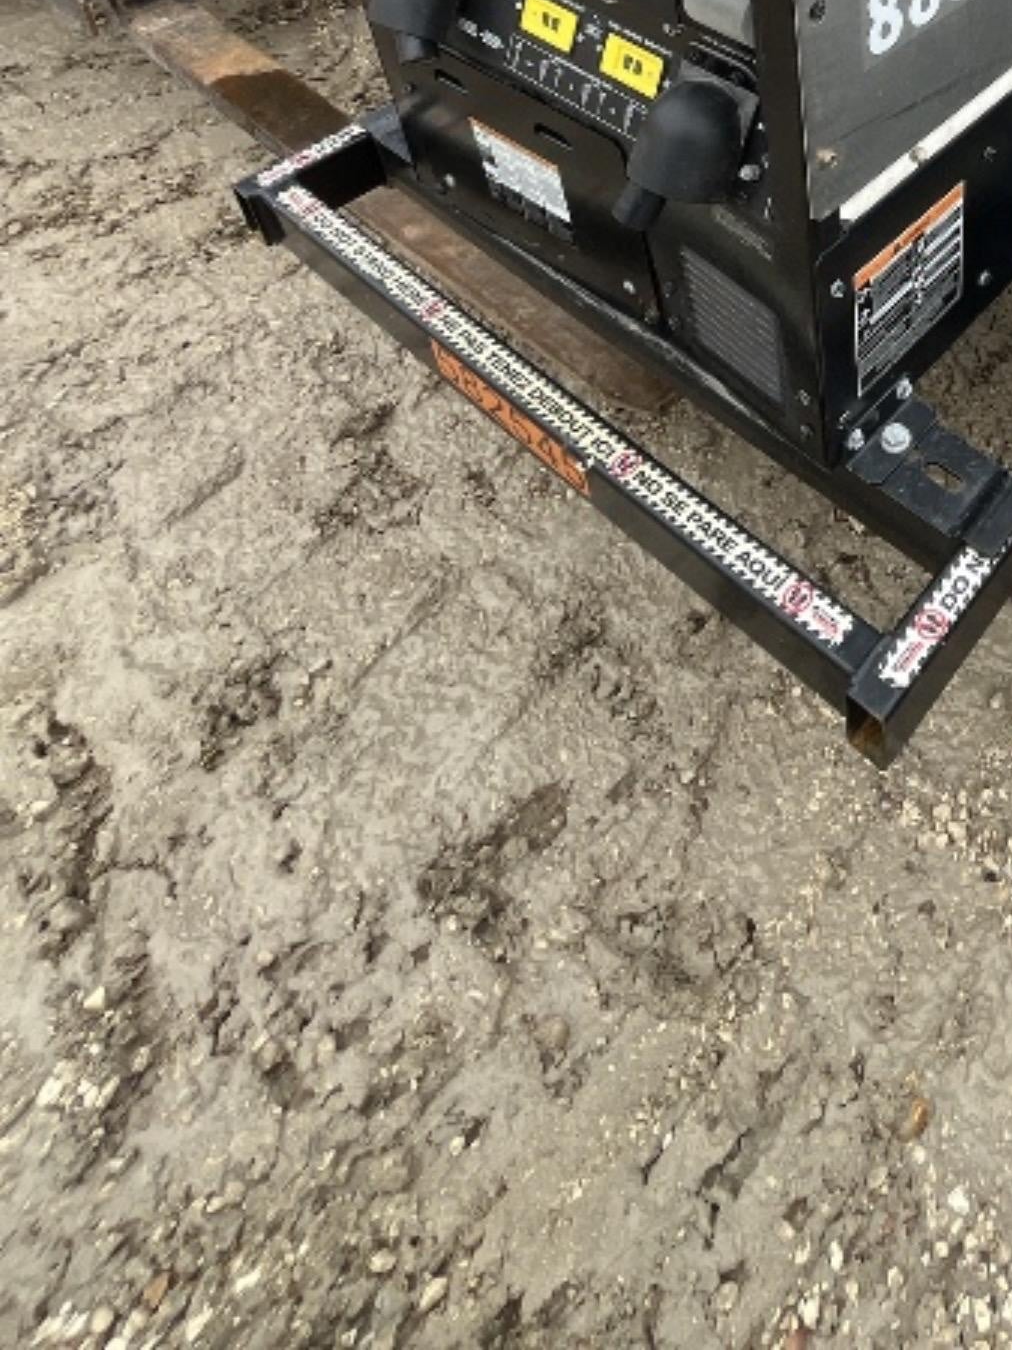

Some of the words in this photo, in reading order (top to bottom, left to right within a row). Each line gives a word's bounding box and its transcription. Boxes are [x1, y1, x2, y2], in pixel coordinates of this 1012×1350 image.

[484, 348, 532, 391] TENEZ
[526, 382, 593, 441] DEBOUT
[631, 467, 664, 498] NO
[658, 488, 689, 517] SE
[684, 507, 740, 555] PARE
[935, 571, 974, 612] DO
